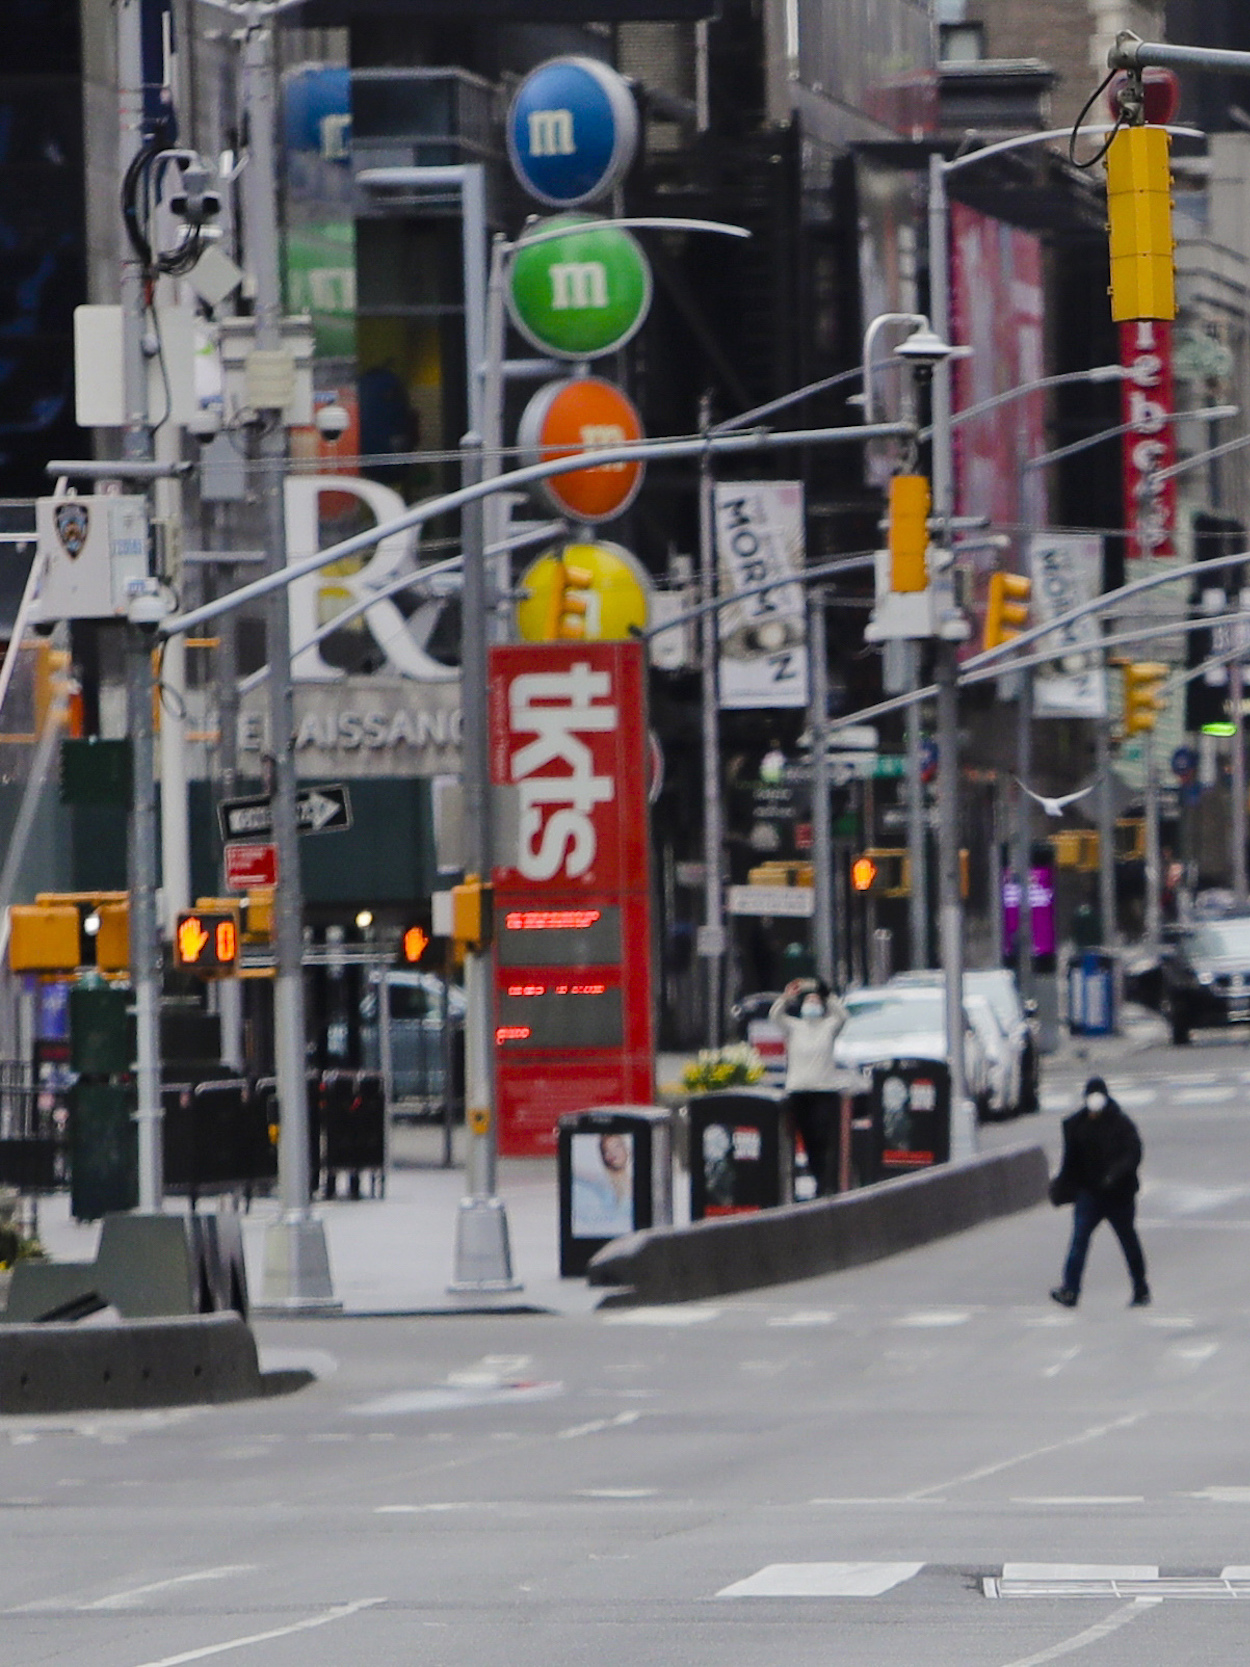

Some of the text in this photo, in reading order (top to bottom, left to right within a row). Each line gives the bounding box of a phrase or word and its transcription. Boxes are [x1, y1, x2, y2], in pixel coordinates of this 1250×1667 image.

[528, 109, 576, 157] m
[549, 262, 608, 310] m
[580, 424, 626, 472] m
[284, 475, 461, 682] R
[508, 662, 618, 882] tkts
